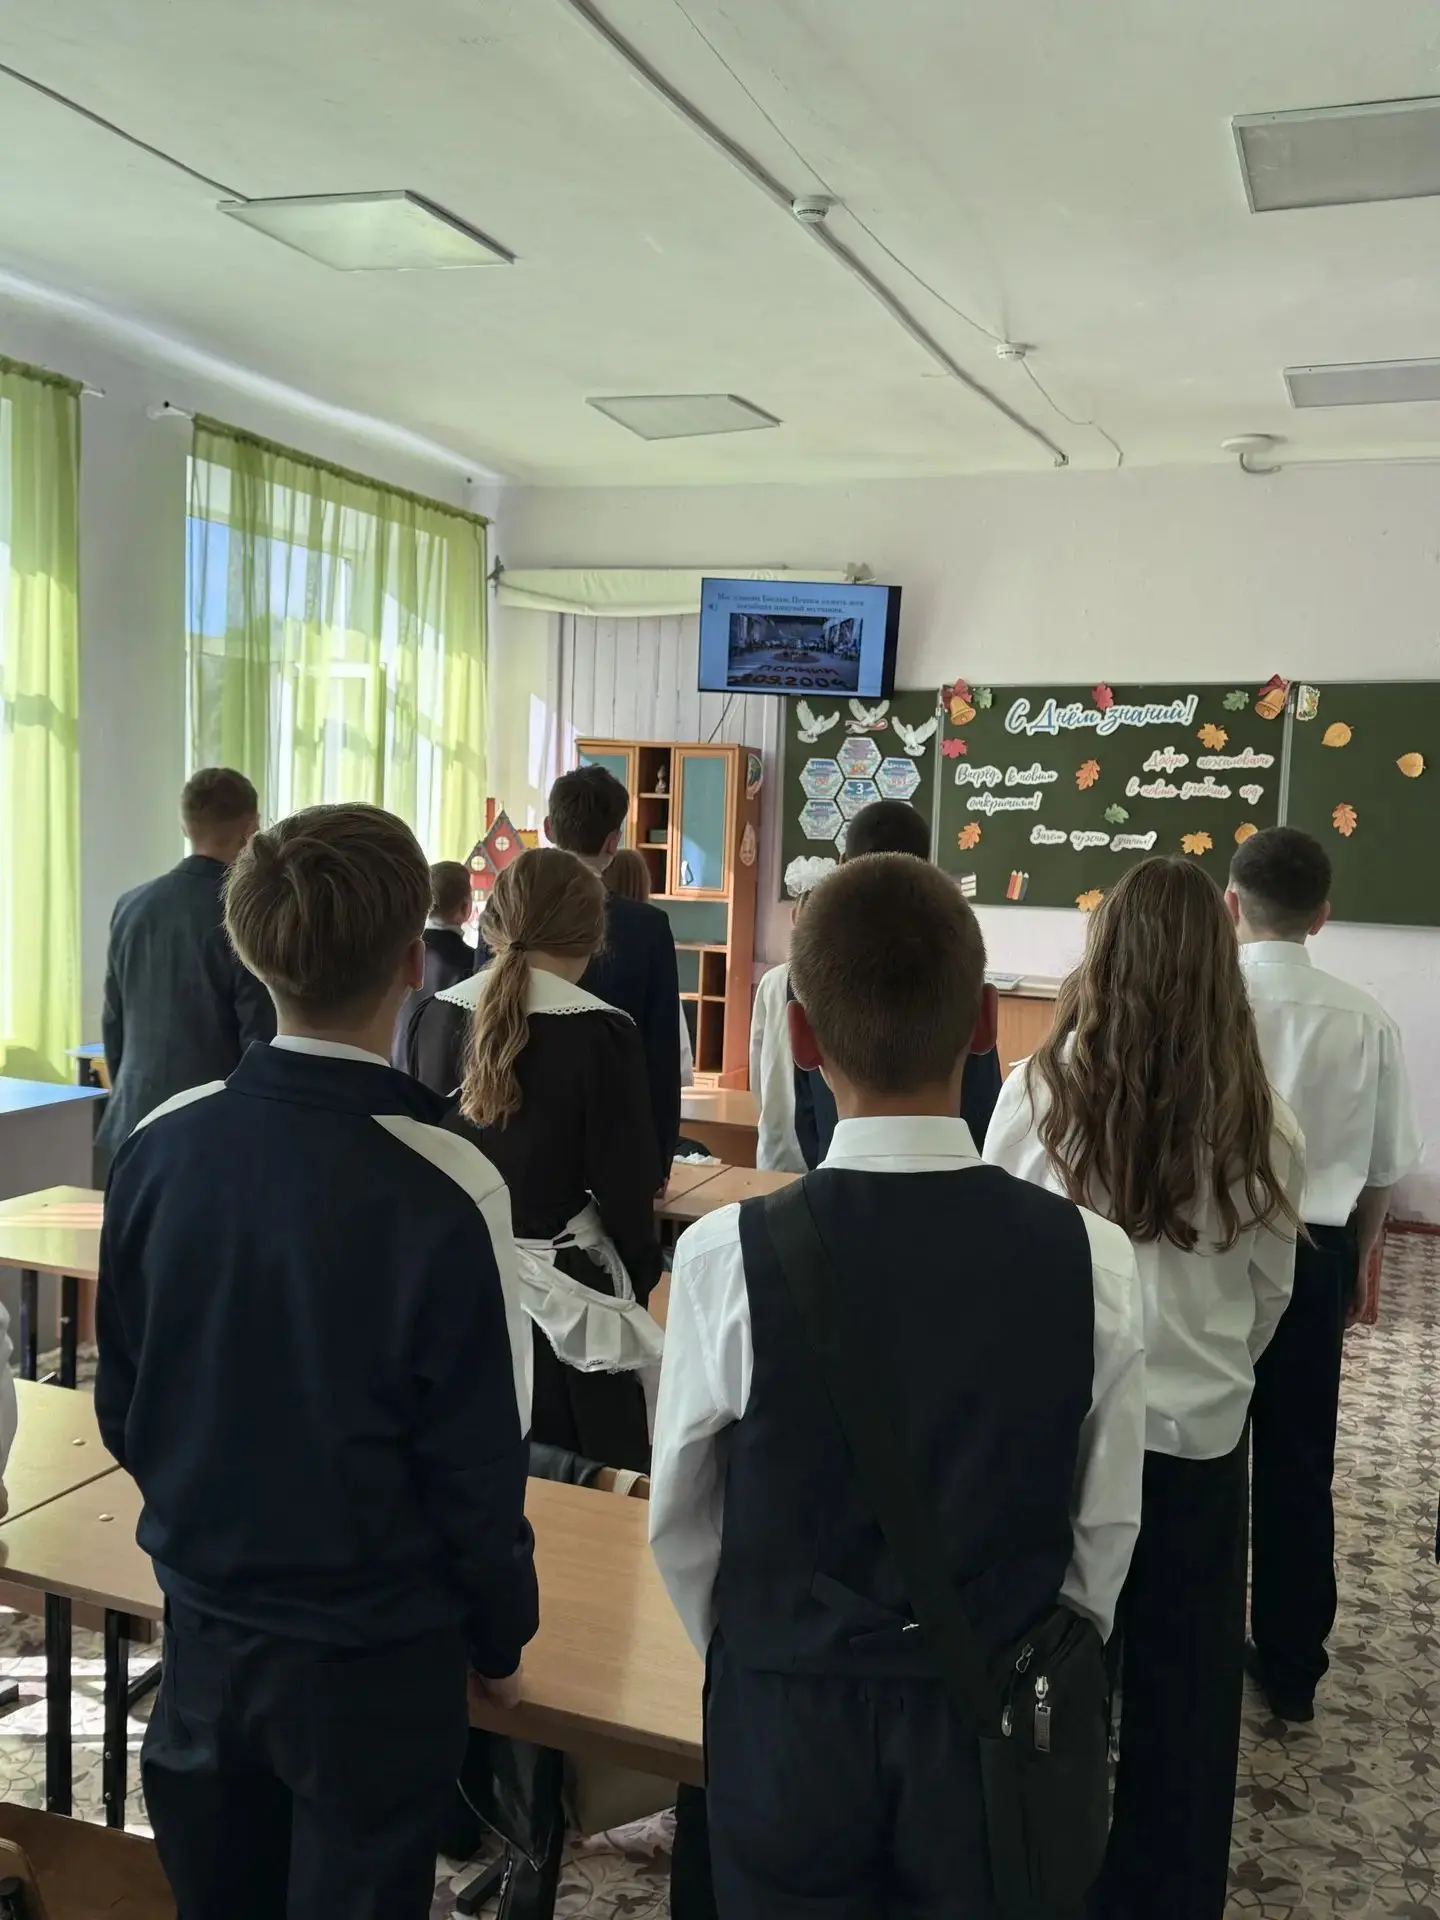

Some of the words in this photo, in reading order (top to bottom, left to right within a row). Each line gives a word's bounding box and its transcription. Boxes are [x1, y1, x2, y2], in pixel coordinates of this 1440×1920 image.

[1006, 699, 1029, 733] С
[1028, 699, 1100, 734] Днём
[1099, 695, 1199, 734] знаний!
[1144, 748, 1188, 772] Добро
[1198, 748, 1273, 769] пожаловать
[1018, 764, 1057, 783] новым
[856, 782, 864, 795] 3
[1126, 777, 1140, 796] в
[1141, 779, 1177, 797] новый
[1181, 777, 1230, 799] учебный
[1240, 785, 1263, 804] год
